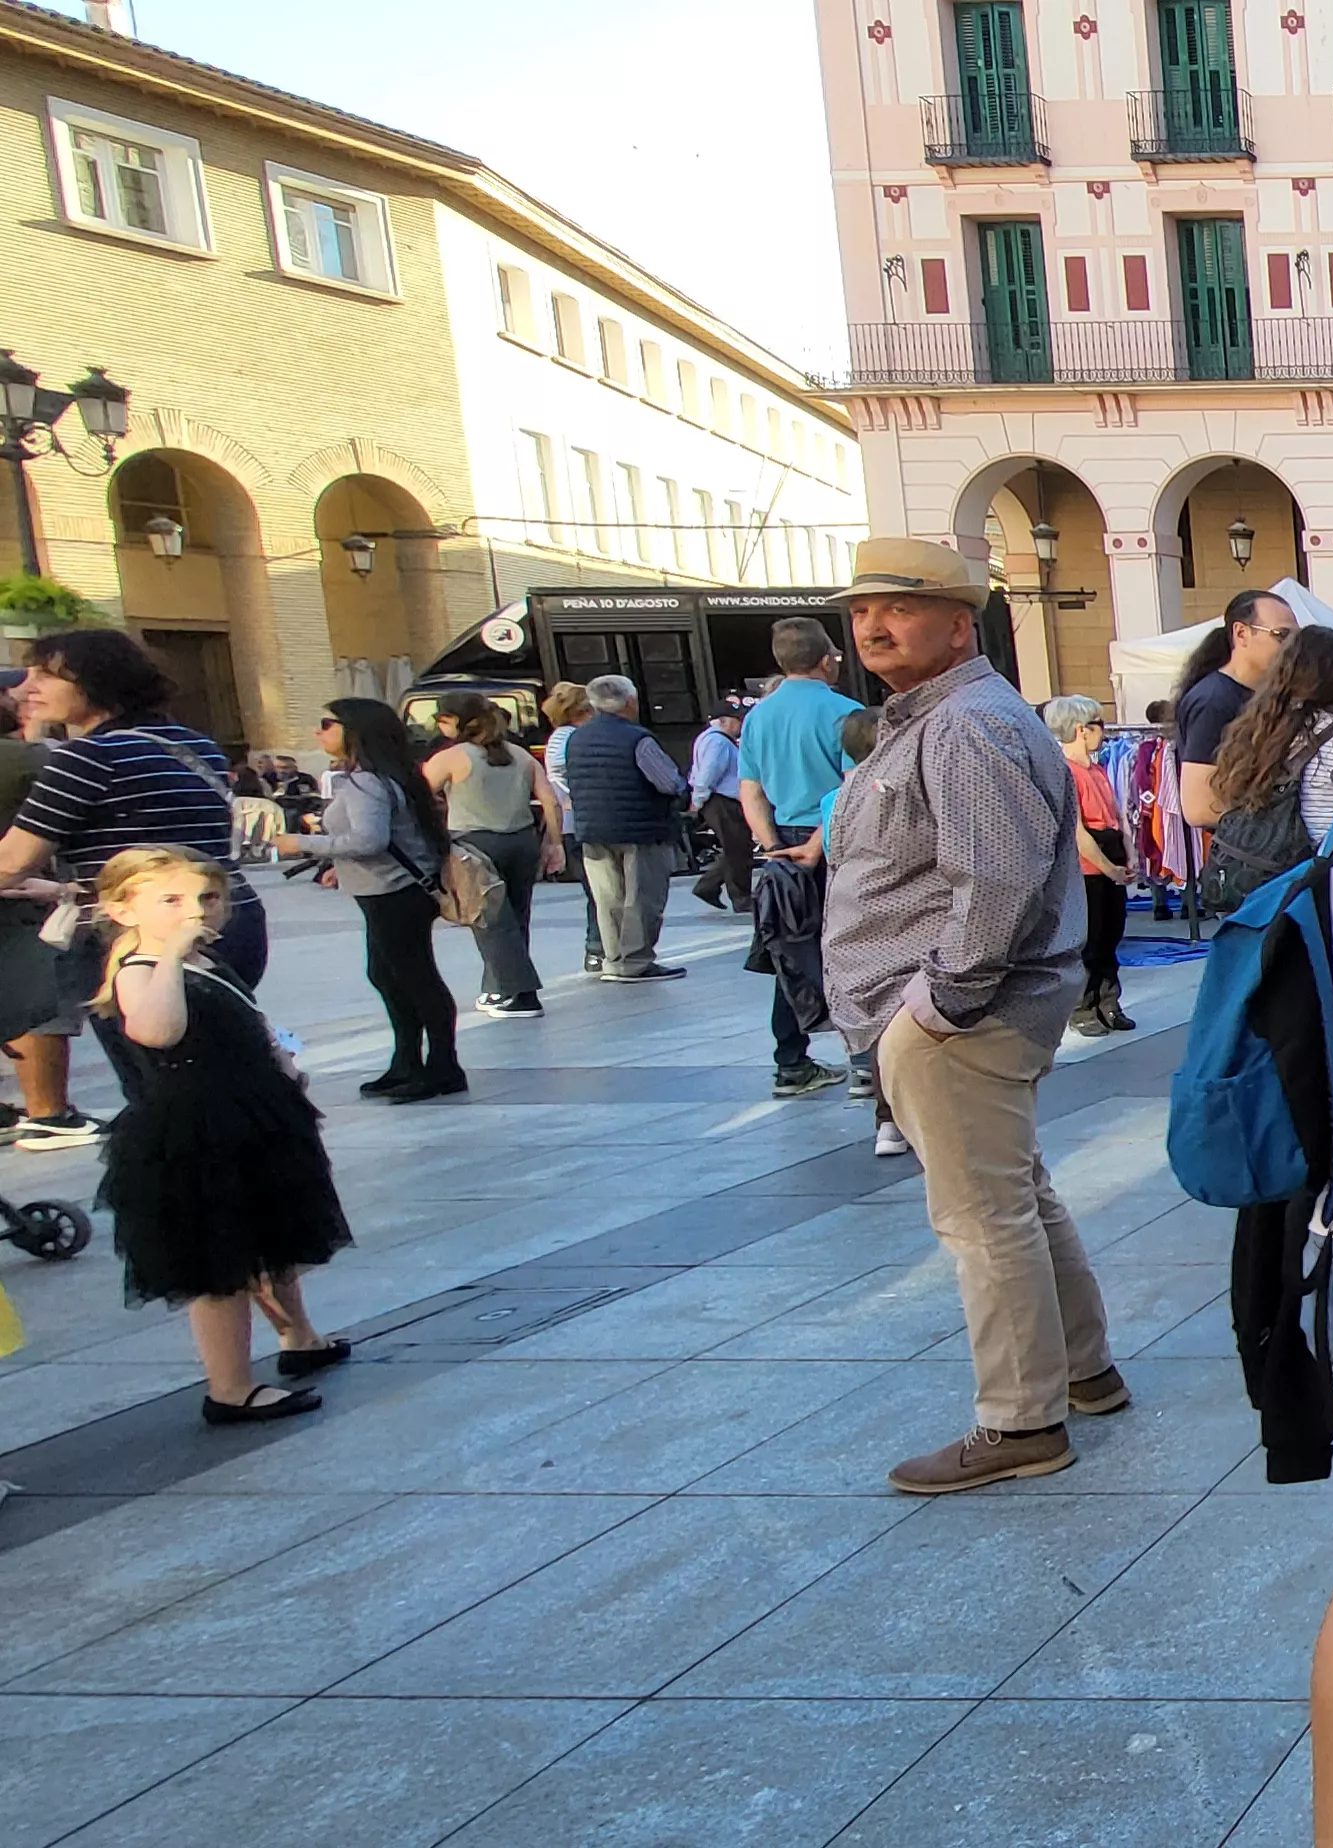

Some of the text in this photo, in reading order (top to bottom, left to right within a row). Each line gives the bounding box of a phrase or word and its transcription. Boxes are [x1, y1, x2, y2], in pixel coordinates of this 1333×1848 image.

[563, 596, 598, 609] PEÑA
[615, 597, 679, 609] D'AGOSTO
[706, 595, 827, 606] WWW.SONIDO54.CO
